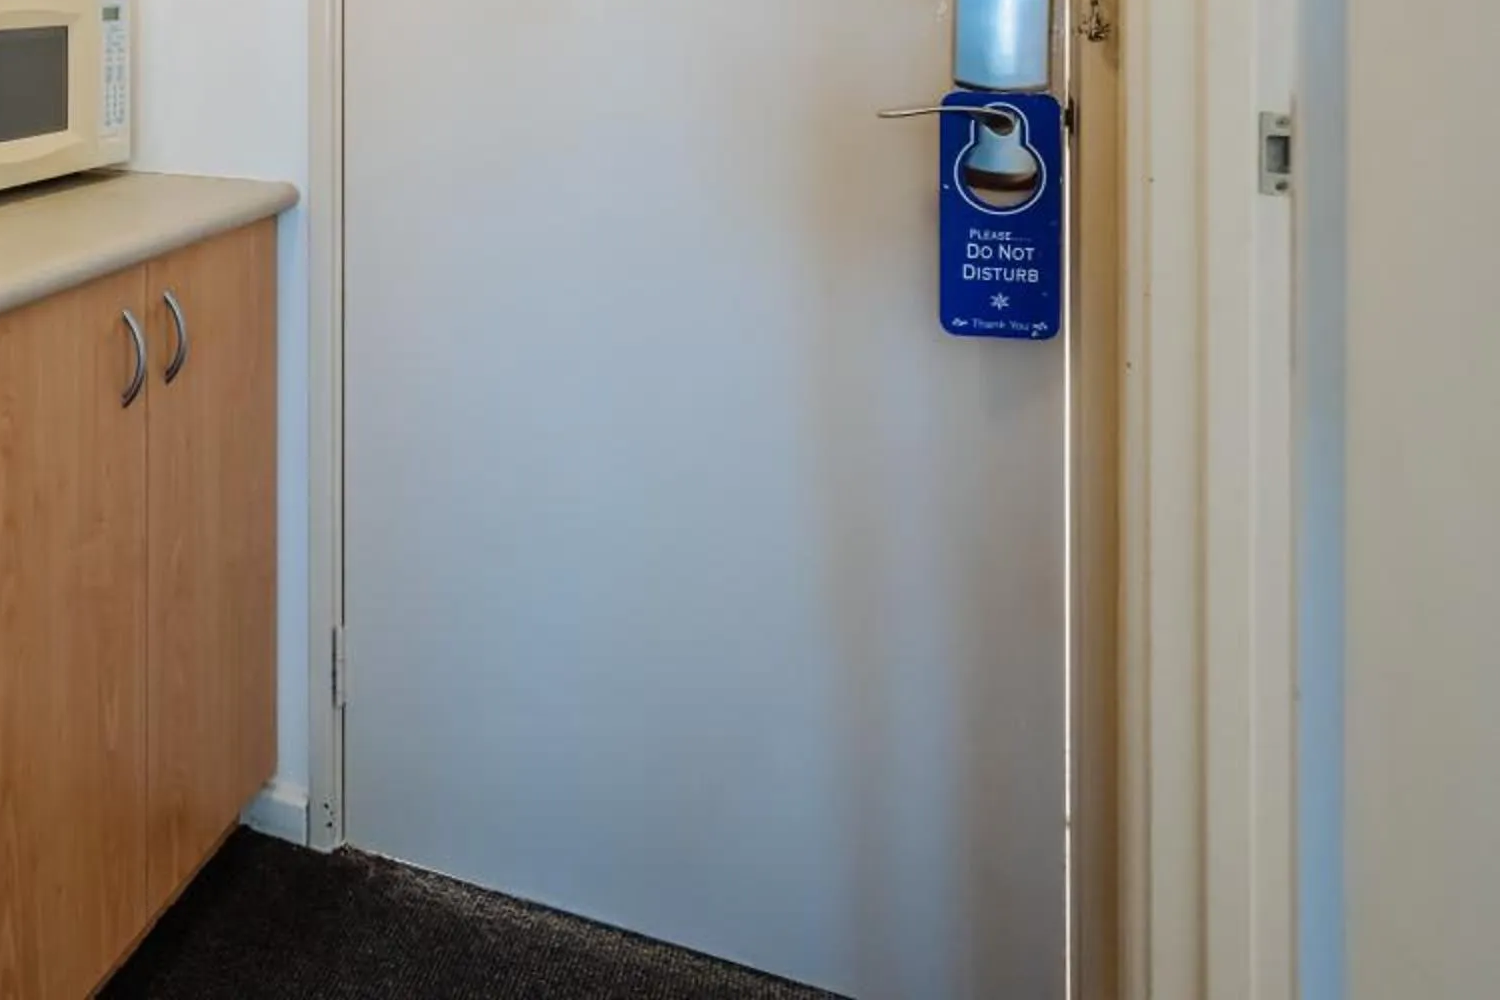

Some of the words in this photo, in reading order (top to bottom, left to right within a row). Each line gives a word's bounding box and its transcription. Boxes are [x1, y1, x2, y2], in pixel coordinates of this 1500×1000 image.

[967, 243, 993, 259] DO
[999, 244, 1035, 261] NOT
[963, 263, 1039, 282] DISTURB
